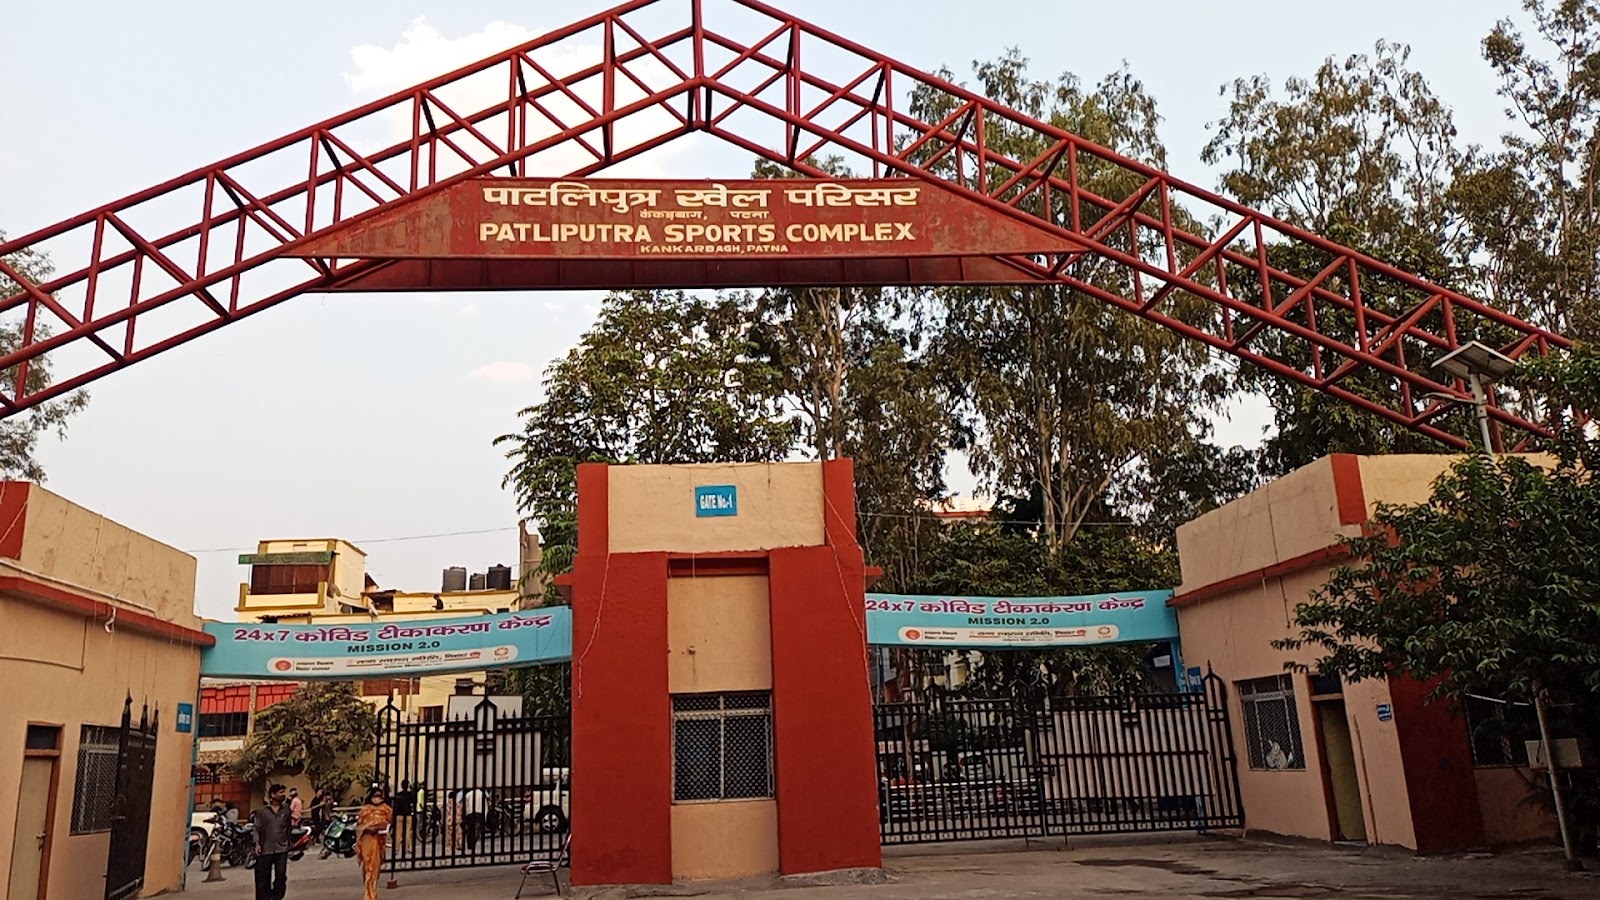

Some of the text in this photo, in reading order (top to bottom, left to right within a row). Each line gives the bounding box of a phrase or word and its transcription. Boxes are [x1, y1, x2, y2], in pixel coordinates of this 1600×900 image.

[483, 182, 921, 213] पाटलिपुत्र खेल परिसर
[729, 210, 770, 220] पटना
[479, 222, 916, 243] PATLIPUTRA SPORTS COMPLEX
[700, 494, 716, 509] GATE
[866, 597, 1146, 614] 24x7 कोविड टीकाकरण केन्द्र
[234, 615, 553, 643] 24x7 कोविड टीकाकरण केन्द्र
[967, 616, 1050, 626] MISSION 2.0
[347, 640, 441, 653] MISSION 2.0
